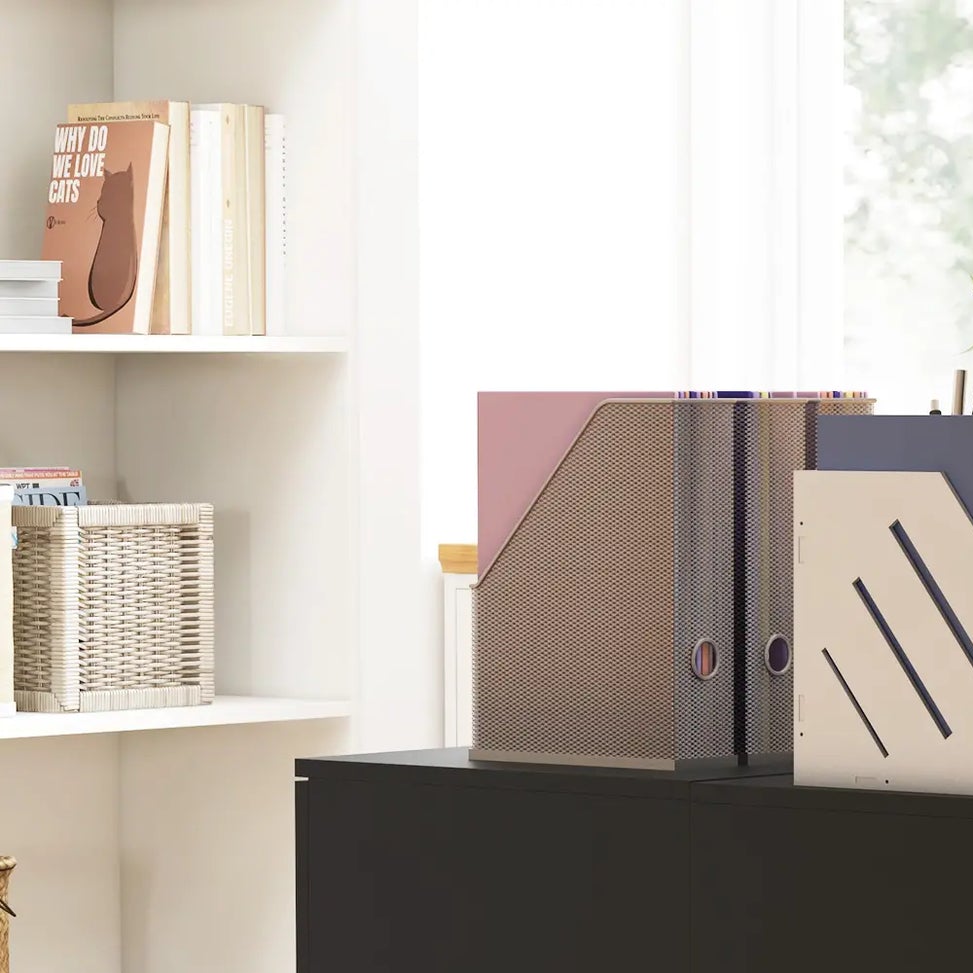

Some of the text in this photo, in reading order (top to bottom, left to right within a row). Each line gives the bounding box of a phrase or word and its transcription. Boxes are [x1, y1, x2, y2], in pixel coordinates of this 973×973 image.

[54, 125, 109, 153] WHY DO
[52, 153, 106, 179] WE LOVE
[48, 179, 81, 204] CATS
